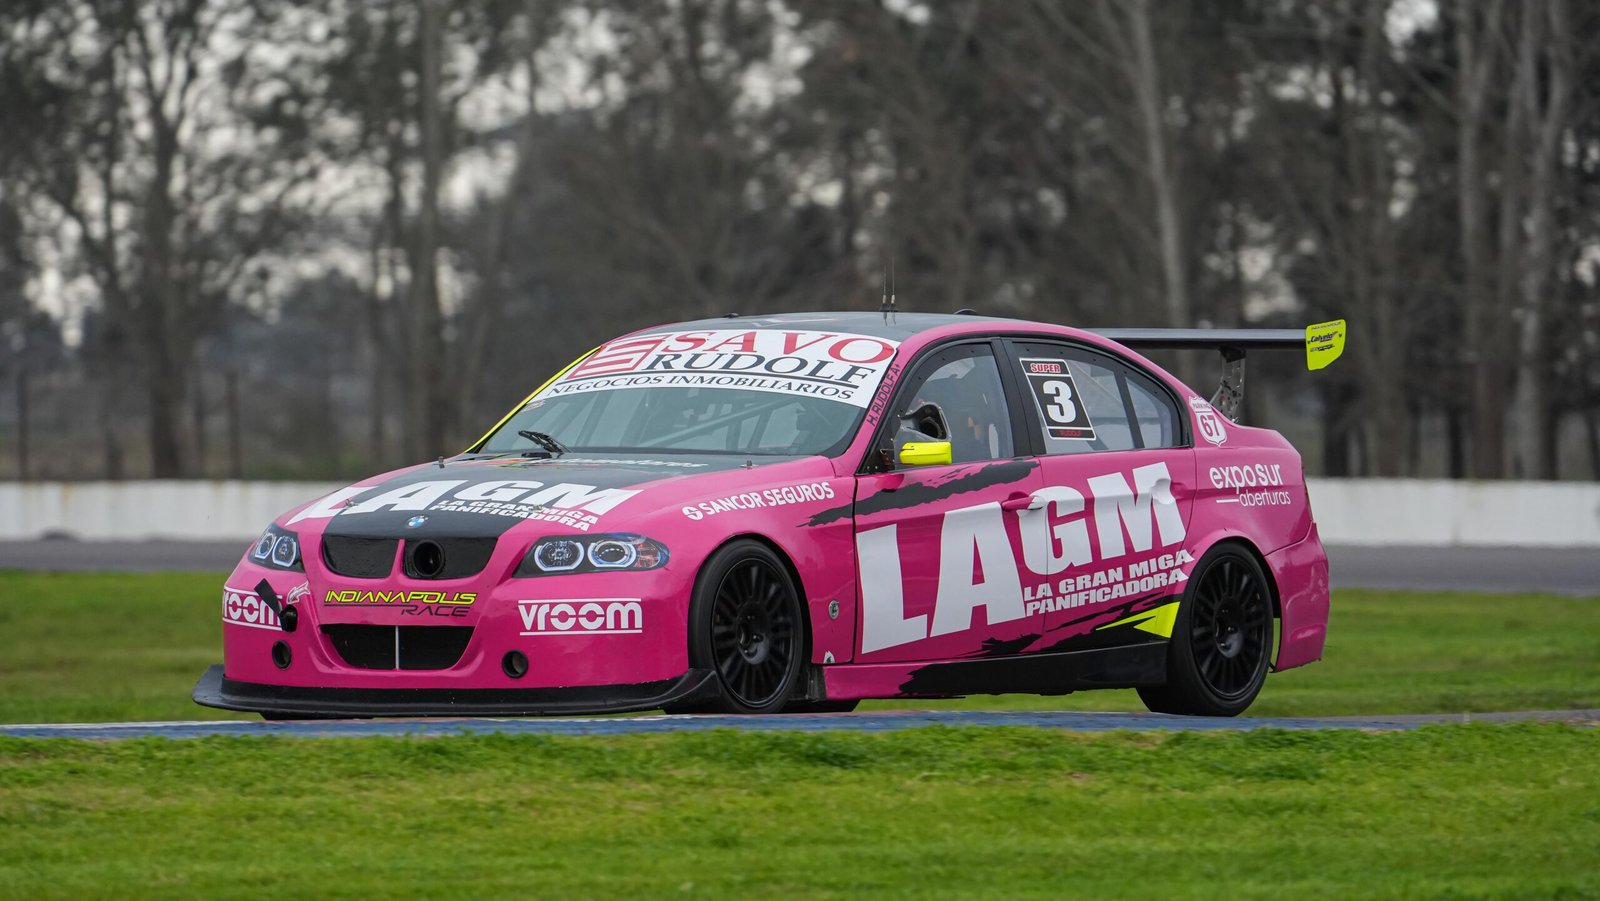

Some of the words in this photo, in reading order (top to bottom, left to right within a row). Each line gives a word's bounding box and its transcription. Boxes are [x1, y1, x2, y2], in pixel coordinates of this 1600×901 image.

[662, 331, 895, 364] SAVO
[641, 353, 877, 383] RUDOLF
[1030, 363, 1061, 373] SUPER
[547, 375, 665, 396] NEGOCIOS
[668, 375, 854, 400] INMOBILIARIOS
[872, 375, 897, 413] RUDOLF
[1043, 381, 1077, 424] 3
[1200, 415, 1219, 437] 67
[284, 480, 643, 526] LAGM
[699, 492, 767, 515] SANCOR
[763, 481, 835, 507] SEGUROS
[1239, 489, 1291, 507] aberturas
[429, 505, 591, 532] PANIFICADORA
[856, 461, 1188, 654] LAGM
[1023, 583, 1053, 602] LA
[1058, 567, 1124, 594] GRAN
[1128, 549, 1196, 580] MIGA
[324, 590, 478, 605] INDIANAPOLIS
[1025, 567, 1190, 617] PANIFICADORA
[223, 591, 283, 626] room
[401, 605, 471, 617] RACE
[518, 602, 643, 631] vroom
